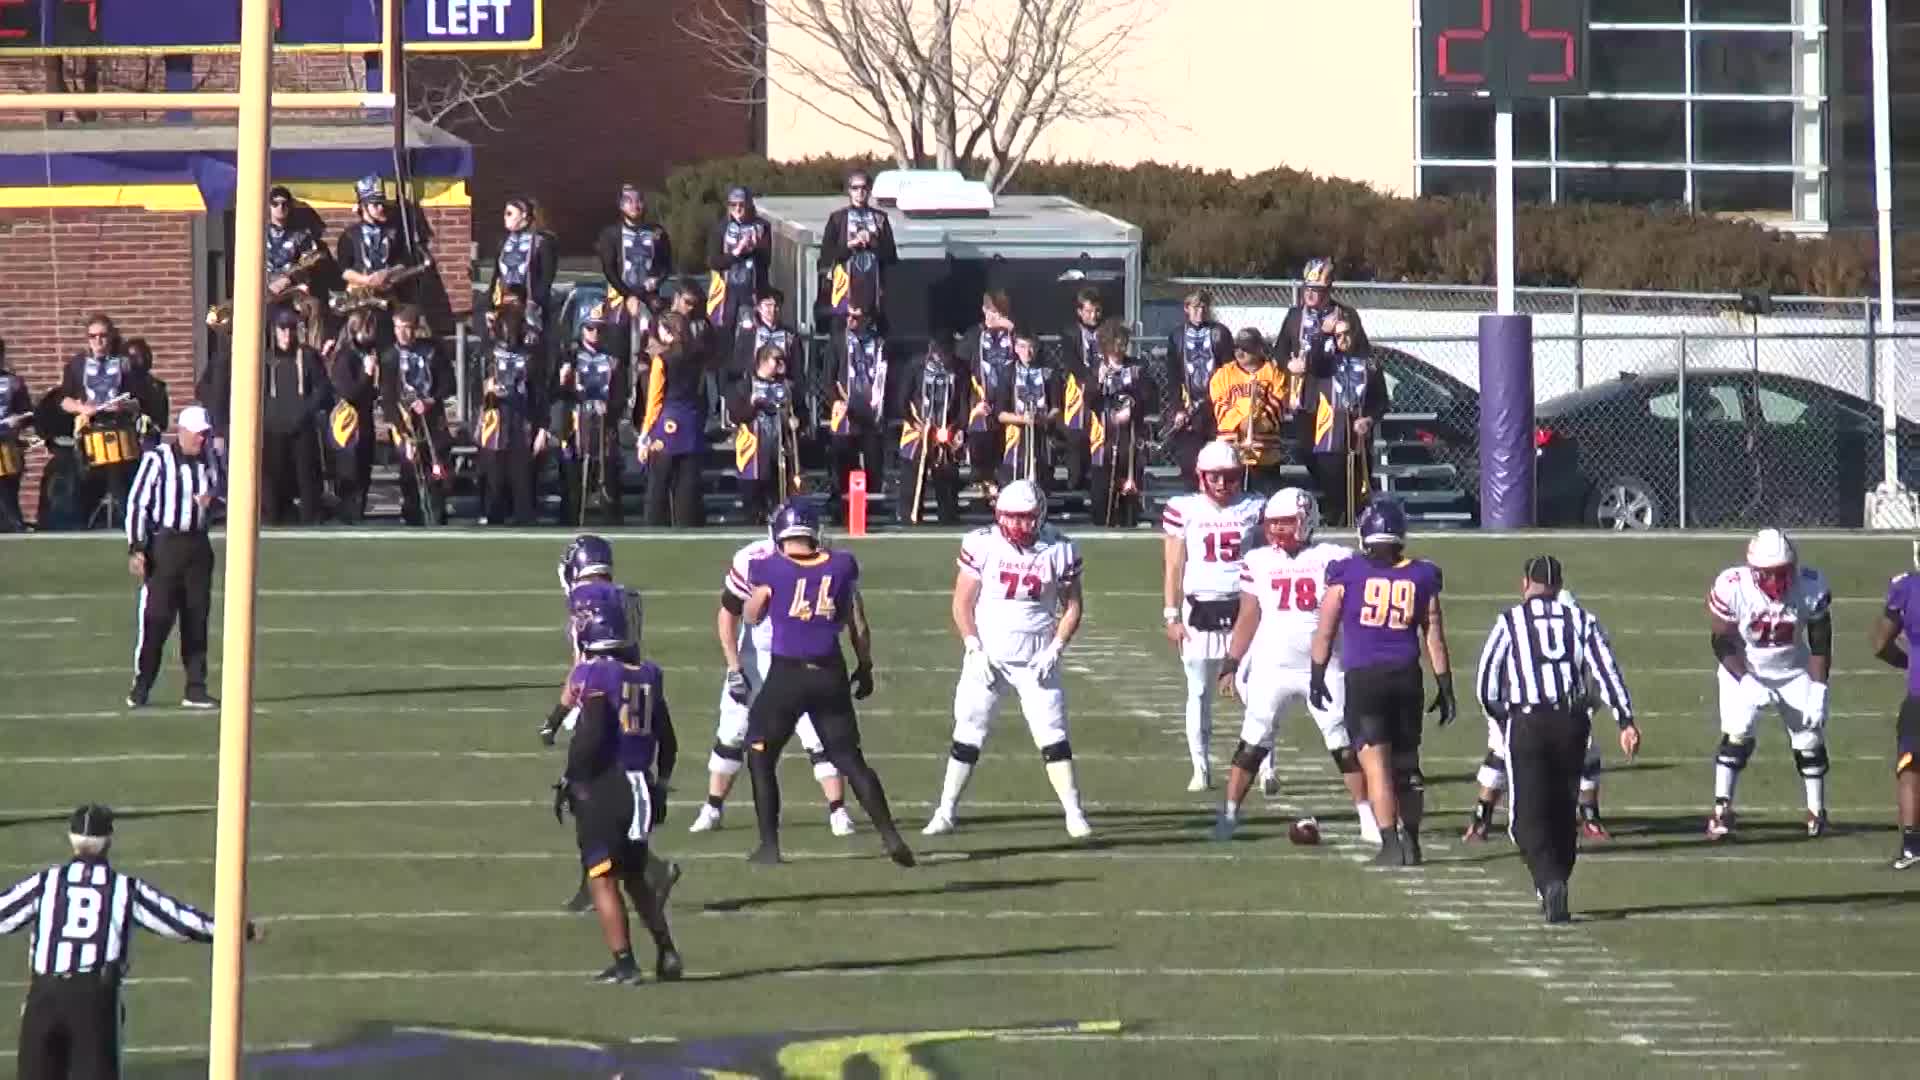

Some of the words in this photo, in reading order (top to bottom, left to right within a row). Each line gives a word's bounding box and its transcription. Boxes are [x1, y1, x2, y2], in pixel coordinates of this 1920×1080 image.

[427, 0, 511, 35] LEFT
[1202, 530, 1241, 563] 15
[788, 575, 837, 622] 44
[1271, 577, 1318, 612] 78
[1359, 576, 1416, 630] 99
[1533, 618, 1566, 660] U
[62, 886, 102, 939] B
